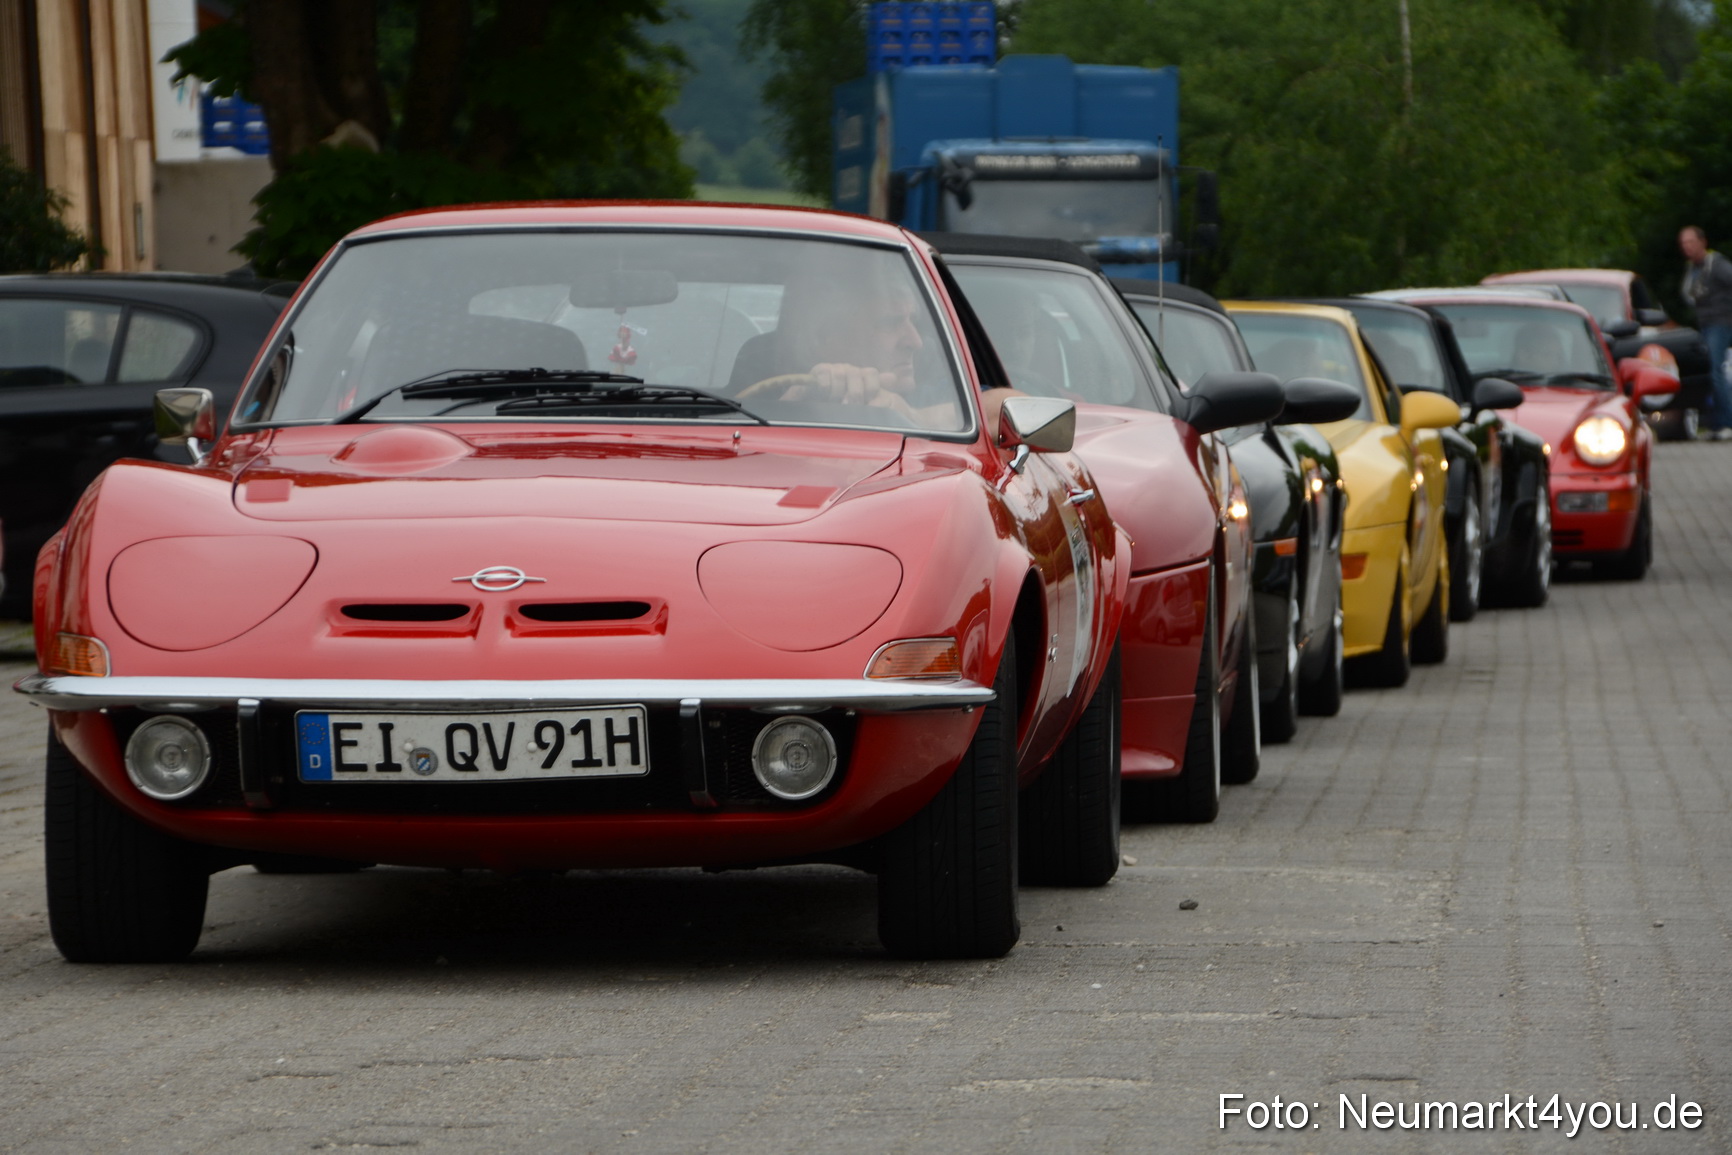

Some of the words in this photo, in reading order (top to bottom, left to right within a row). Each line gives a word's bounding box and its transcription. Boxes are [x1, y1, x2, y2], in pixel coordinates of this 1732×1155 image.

[309, 754, 321, 769] D
[332, 721, 402, 773] EI
[444, 721, 516, 773] QV
[534, 716, 641, 769] 91H
